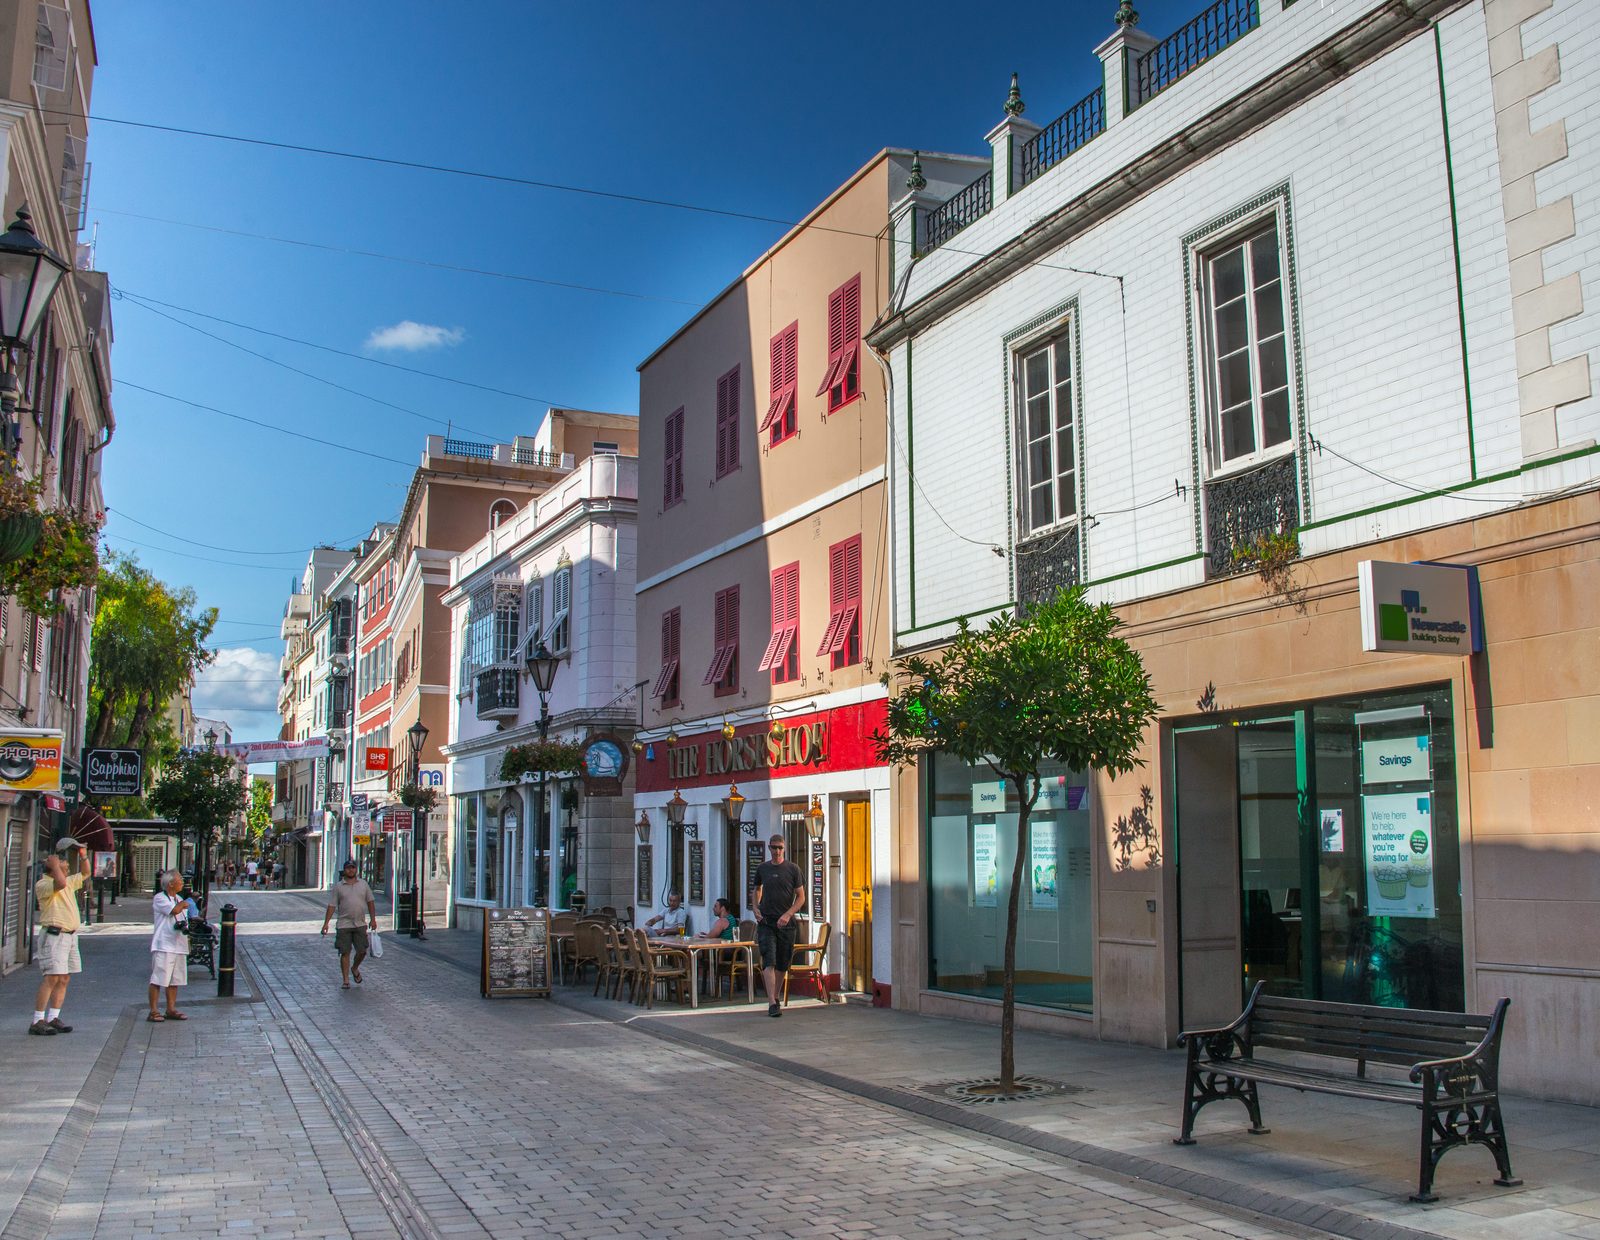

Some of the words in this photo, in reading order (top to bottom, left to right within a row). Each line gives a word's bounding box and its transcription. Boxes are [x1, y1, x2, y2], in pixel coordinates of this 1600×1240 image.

[1411, 618, 1466, 634] Newcastle
[1412, 633, 1437, 644] Building
[1438, 634, 1460, 646] Society
[667, 744, 700, 780] THE
[705, 721, 827, 776] HORSESHOE
[1379, 755, 1412, 767] Savings
[318, 756, 326, 796] TOPSHOP
[981, 793, 997, 802] Savings
[1038, 790, 1059, 799] ortgages
[1371, 811, 1390, 820] We're
[1391, 811, 1407, 820] here
[1372, 821, 1379, 831] to
[1371, 832, 1406, 841] whatever
[1372, 842, 1395, 853] you're
[1372, 853, 1397, 864] saving
[1398, 853, 1409, 862] for
